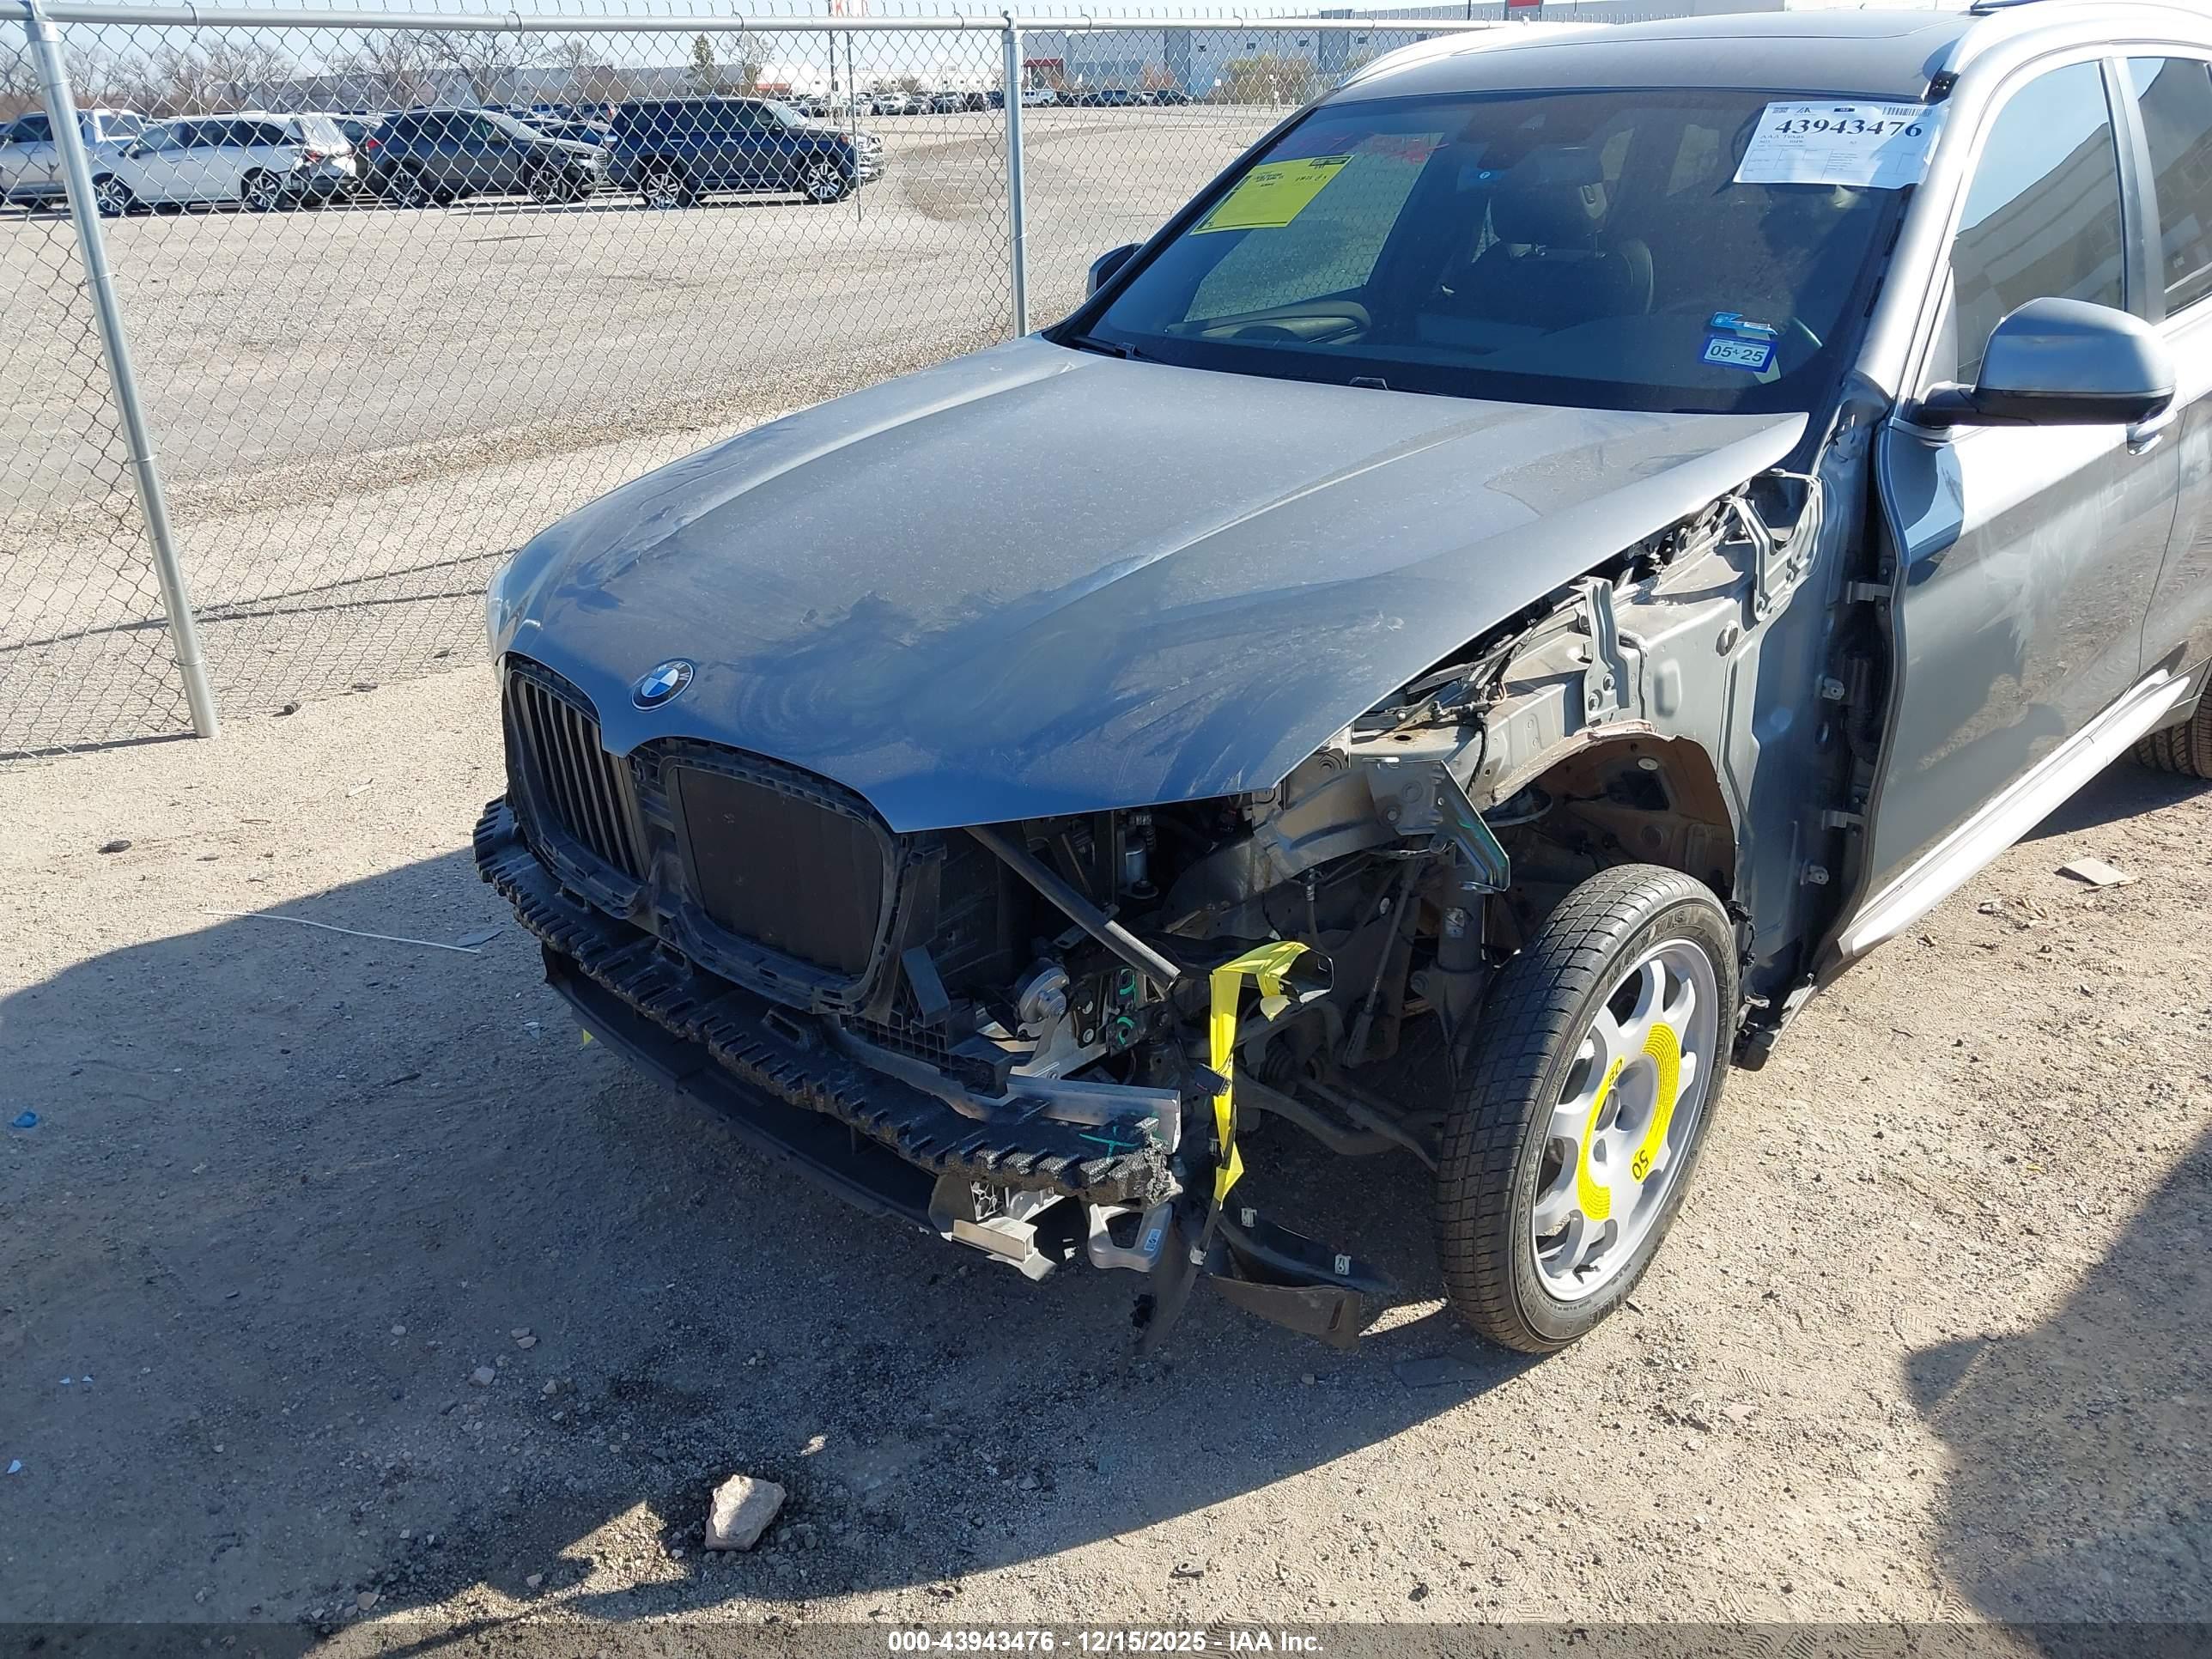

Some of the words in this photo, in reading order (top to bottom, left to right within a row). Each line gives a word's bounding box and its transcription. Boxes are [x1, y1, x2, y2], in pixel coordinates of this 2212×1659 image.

[1775, 118, 1923, 137] 43943476
[1710, 345, 1733, 358] 05
[1740, 349, 1765, 362] 25
[1632, 1149, 1650, 1181] 50
